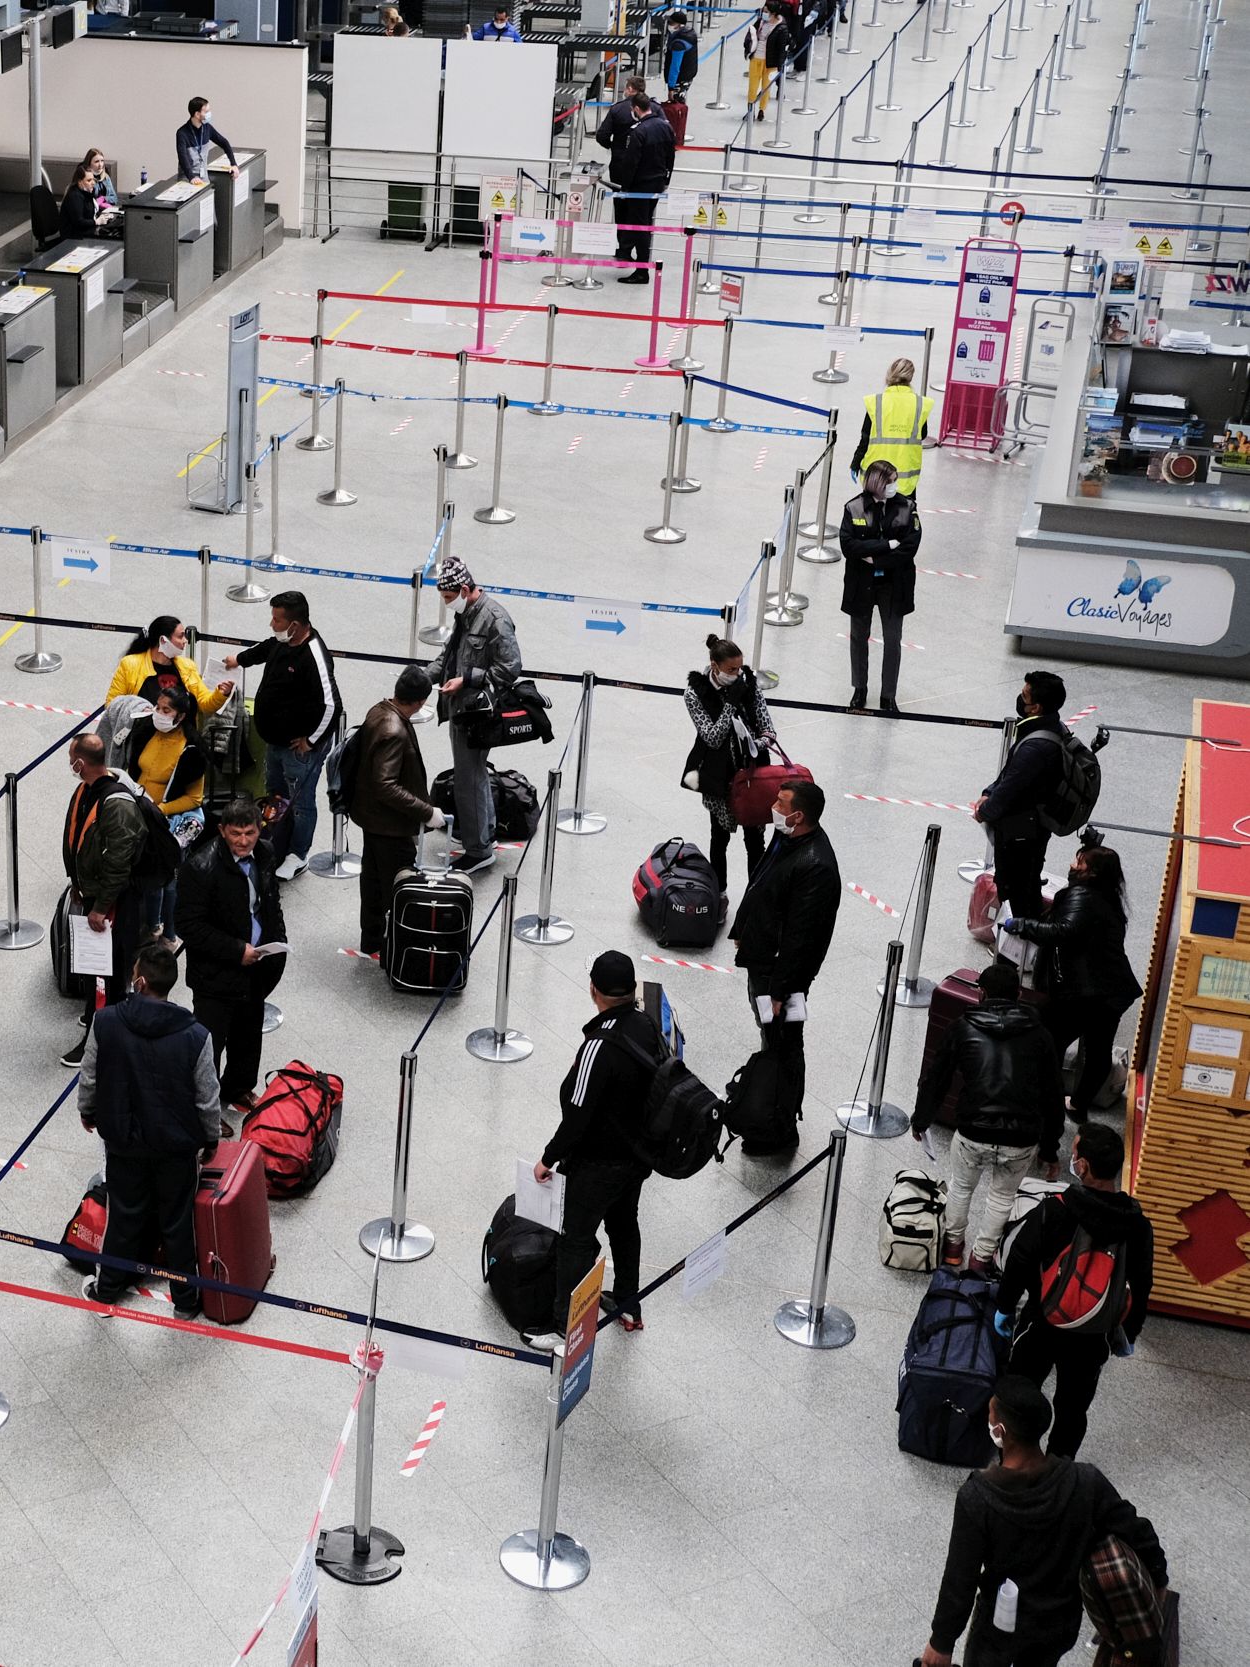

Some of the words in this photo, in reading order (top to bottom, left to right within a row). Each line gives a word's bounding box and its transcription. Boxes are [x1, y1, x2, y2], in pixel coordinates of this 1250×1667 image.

[239, 312, 251, 324] LOT
[509, 724, 533, 735] SPORTS
[672, 904, 708, 914] NEXUS
[150, 1268, 188, 1282] Lufthansa
[309, 1304, 348, 1320] Lufthansa
[569, 1323, 582, 1344] First
[475, 1342, 515, 1358] Lufthansa
[568, 1334, 584, 1356] Class
[563, 1353, 590, 1389] Business
[562, 1380, 579, 1401] Class
